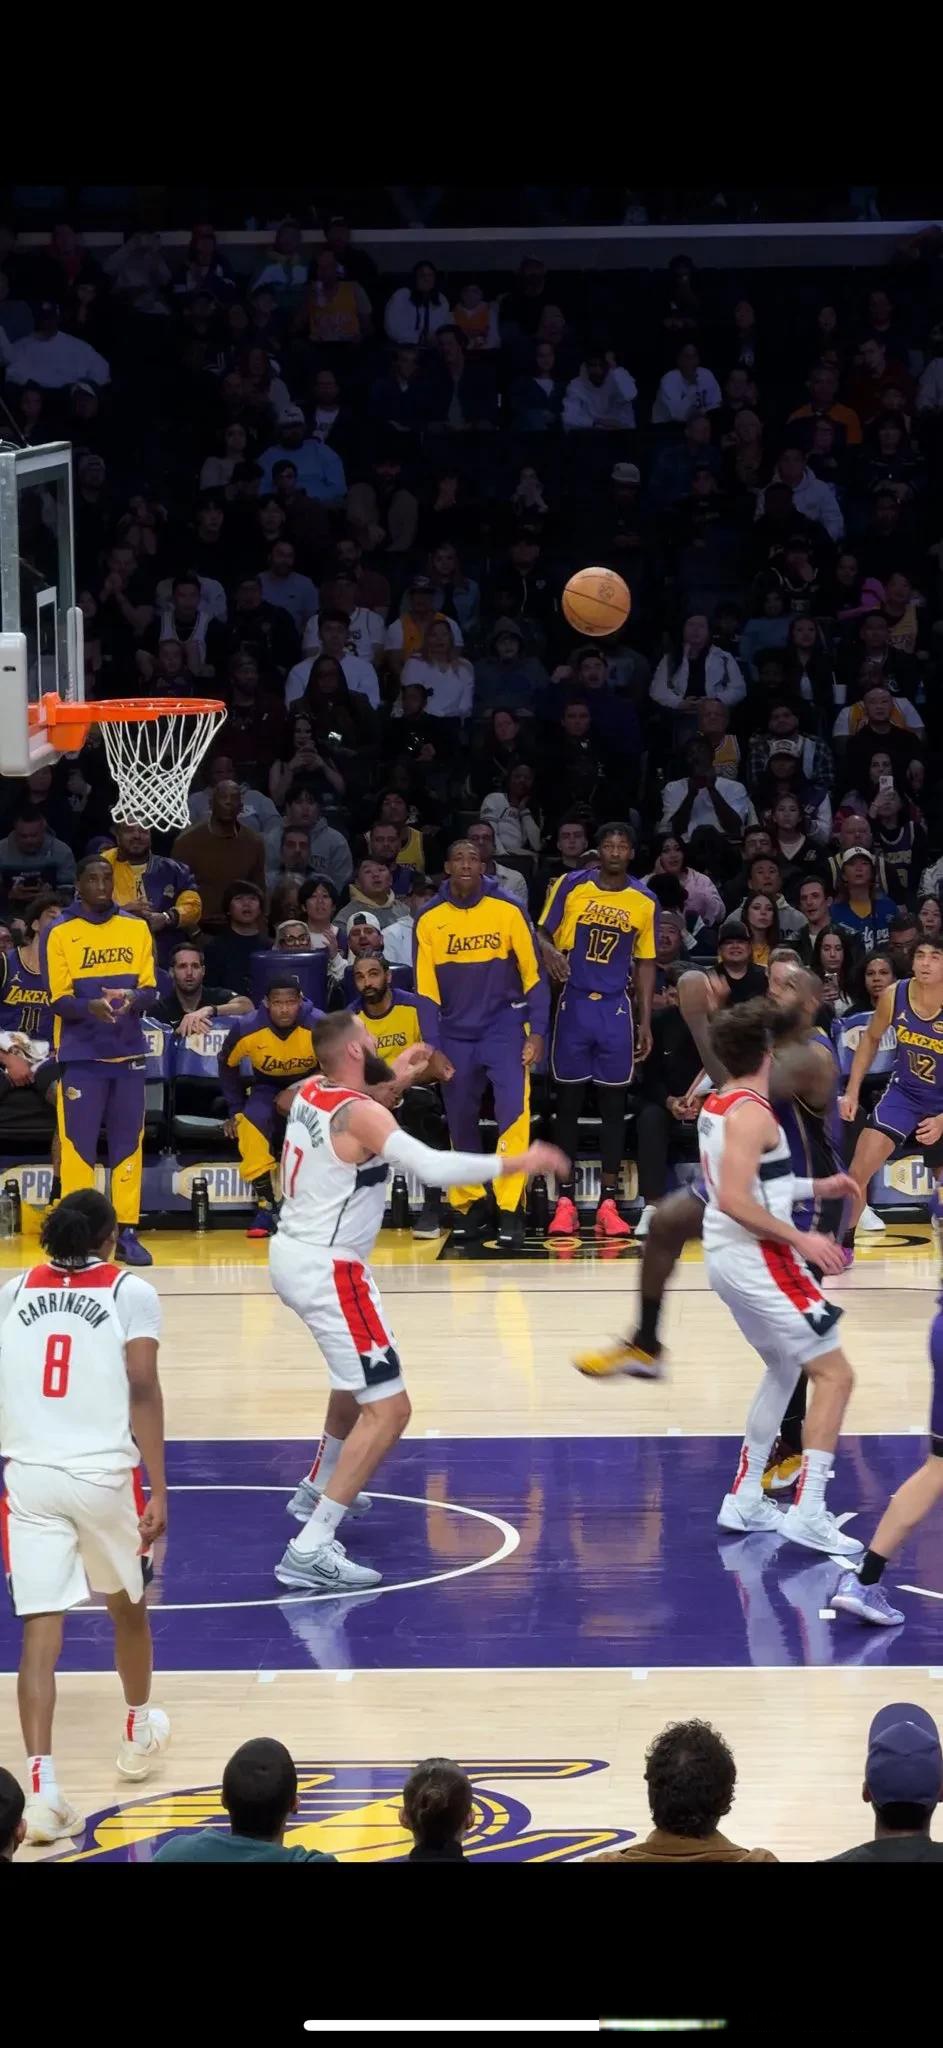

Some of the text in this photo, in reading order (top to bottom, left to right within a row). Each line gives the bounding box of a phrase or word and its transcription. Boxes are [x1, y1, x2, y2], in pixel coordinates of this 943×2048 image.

[80, 946, 134, 969] LAKERS
[446, 932, 502, 955] LAKERS
[586, 929, 620, 964] 17
[260, 1055, 314, 1072] LAKERS
[907, 1049, 936, 1085] 12
[282, 1139, 304, 1199] 17
[18, 1291, 110, 1329] CARRINGTON
[42, 1333, 72, 1399] 8
